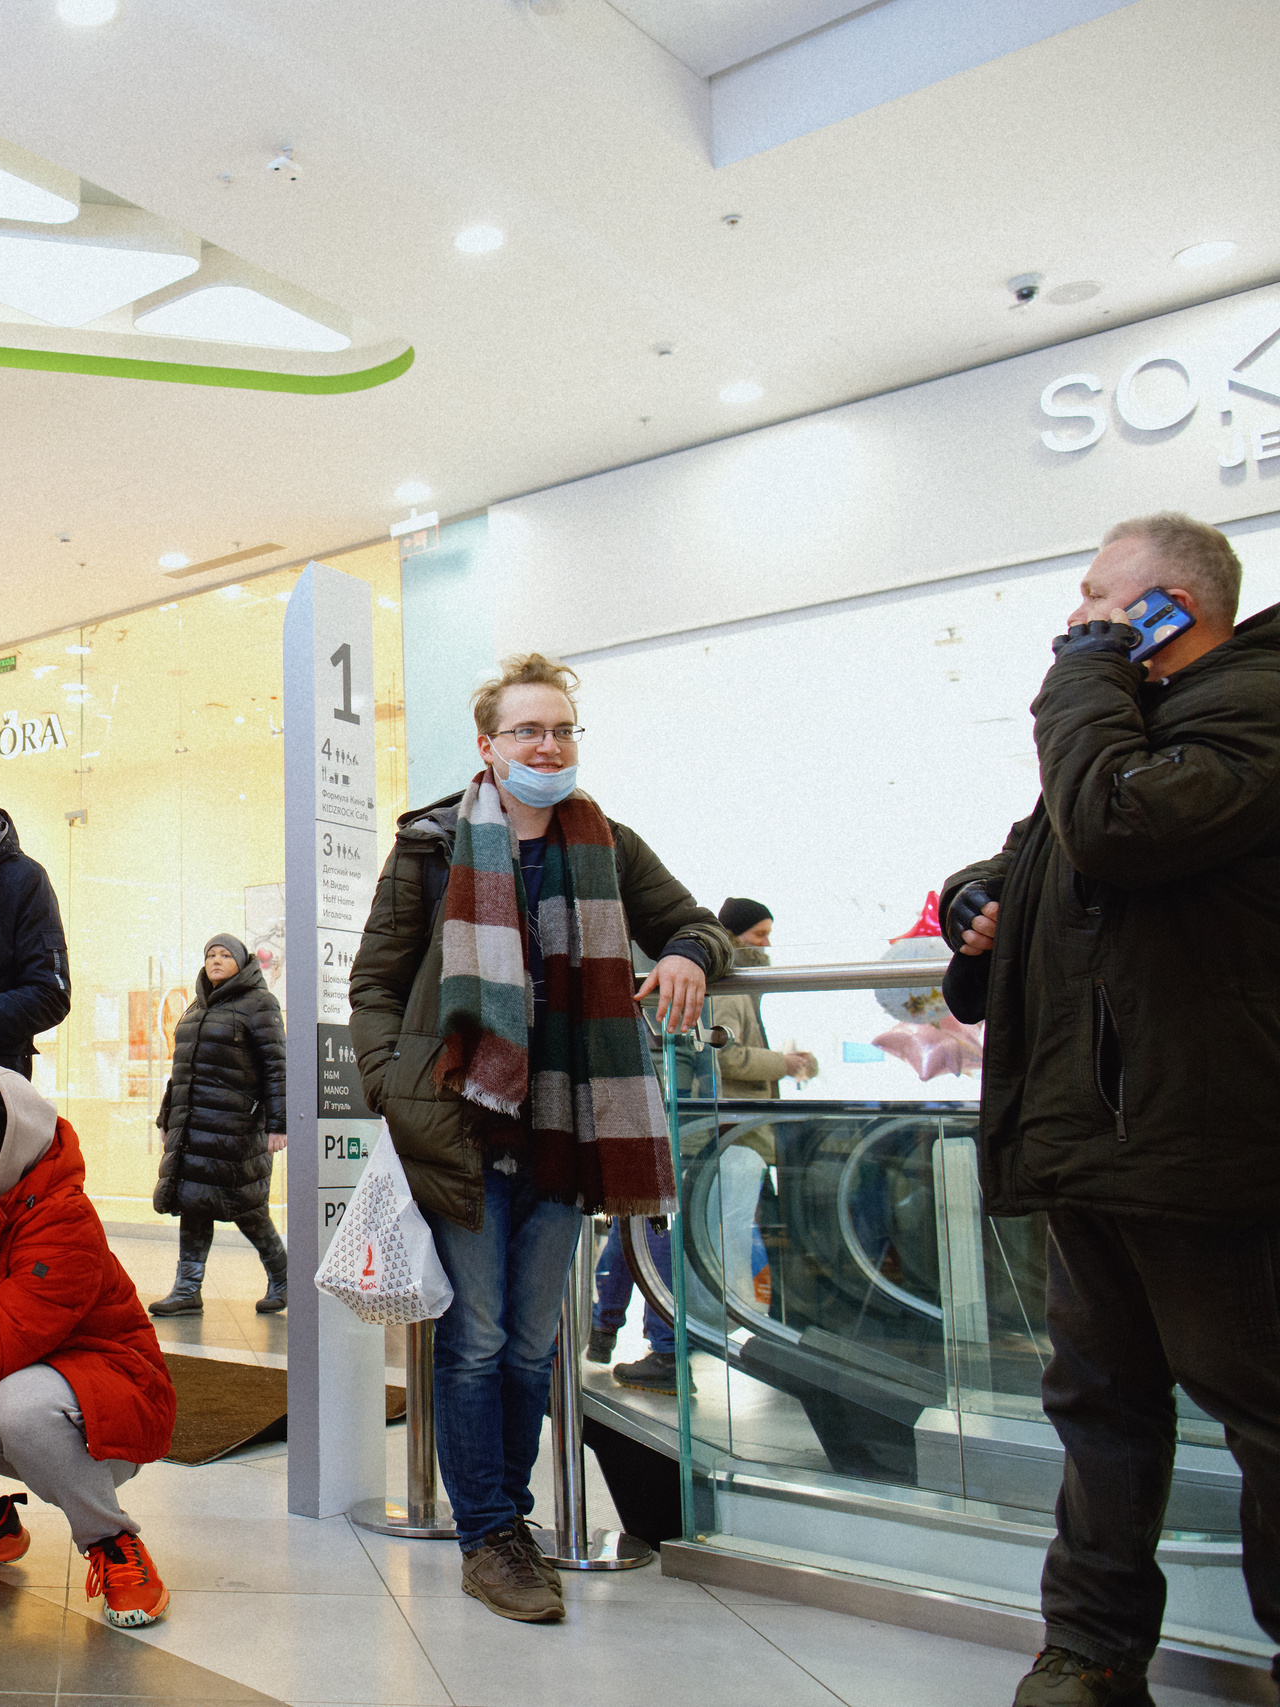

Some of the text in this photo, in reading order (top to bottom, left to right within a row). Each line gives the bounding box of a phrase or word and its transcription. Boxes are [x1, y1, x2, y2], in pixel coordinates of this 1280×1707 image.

[330, 643, 360, 726] 1
[321, 738, 332, 760] 4
[322, 789, 366, 807] Формула Кино
[356, 810, 369, 821] Cafe
[323, 832, 333, 856] 3
[323, 864, 361, 880] Детский мир
[323, 879, 349, 891] М.Видео
[323, 893, 355, 907] Hoff Home
[323, 909, 352, 920] Иголочка
[324, 942, 334, 966] 2
[323, 989, 349, 1000] Якитори
[325, 1037, 335, 1062] 1
[323, 1070, 340, 1080] H&M
[323, 1085, 349, 1095] MANGO
[325, 1134, 346, 1159] P1
[325, 1201, 346, 1227] P2
